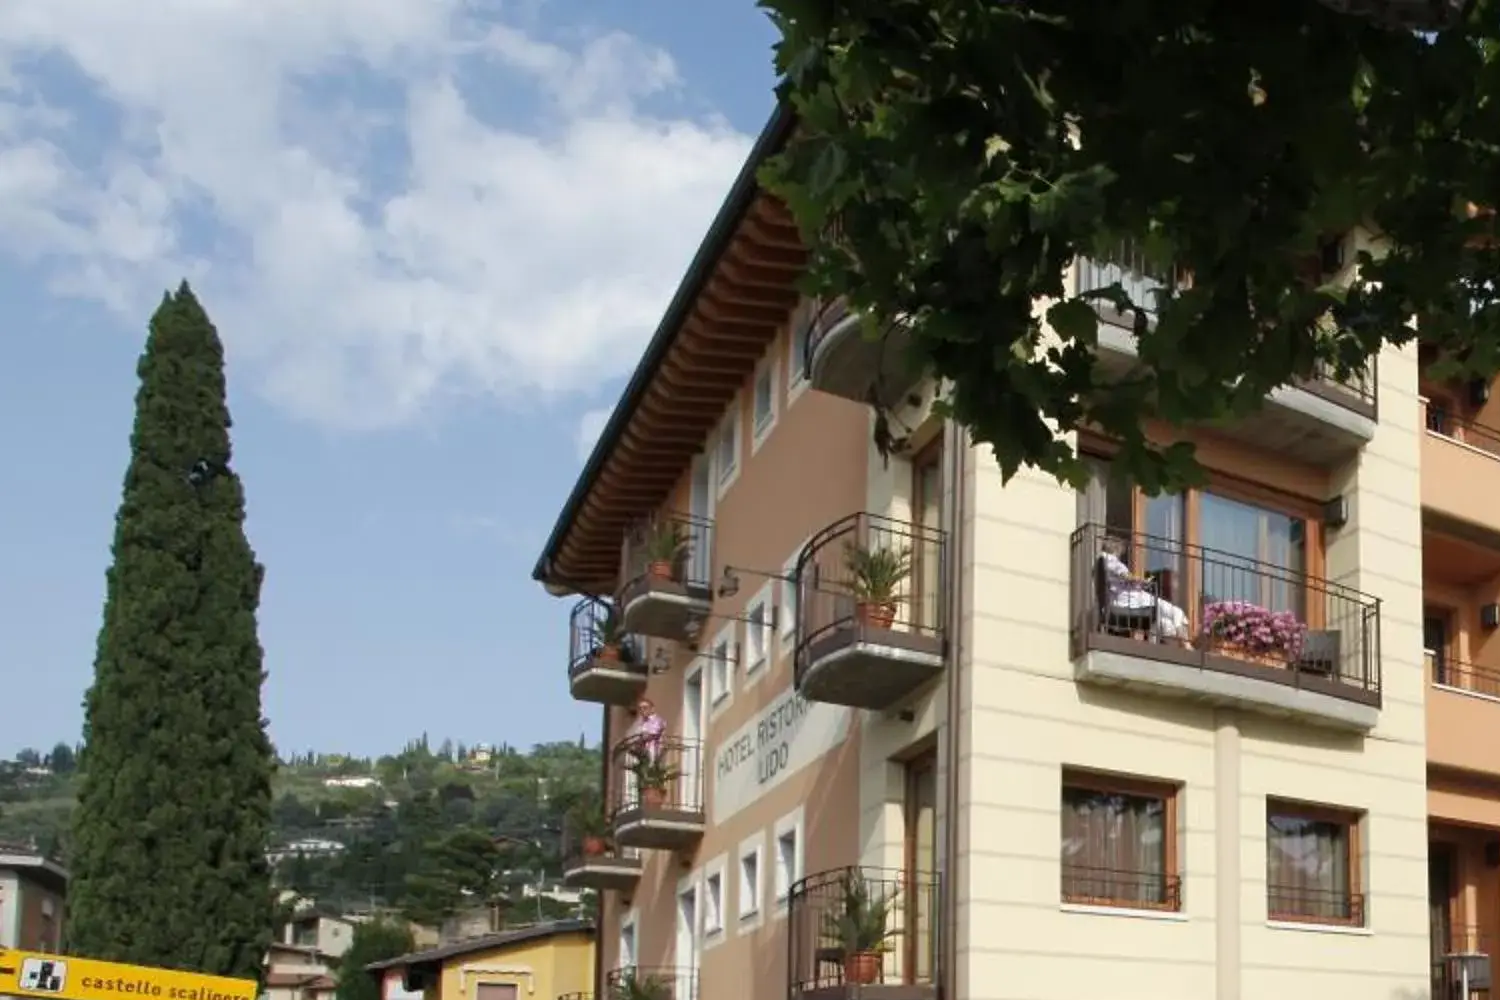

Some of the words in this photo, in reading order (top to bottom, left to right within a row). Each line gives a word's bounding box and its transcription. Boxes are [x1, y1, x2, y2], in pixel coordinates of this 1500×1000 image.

[718, 733, 755, 781] HOTEL
[758, 741, 789, 785] LIDO
[81, 974, 162, 997] castello
